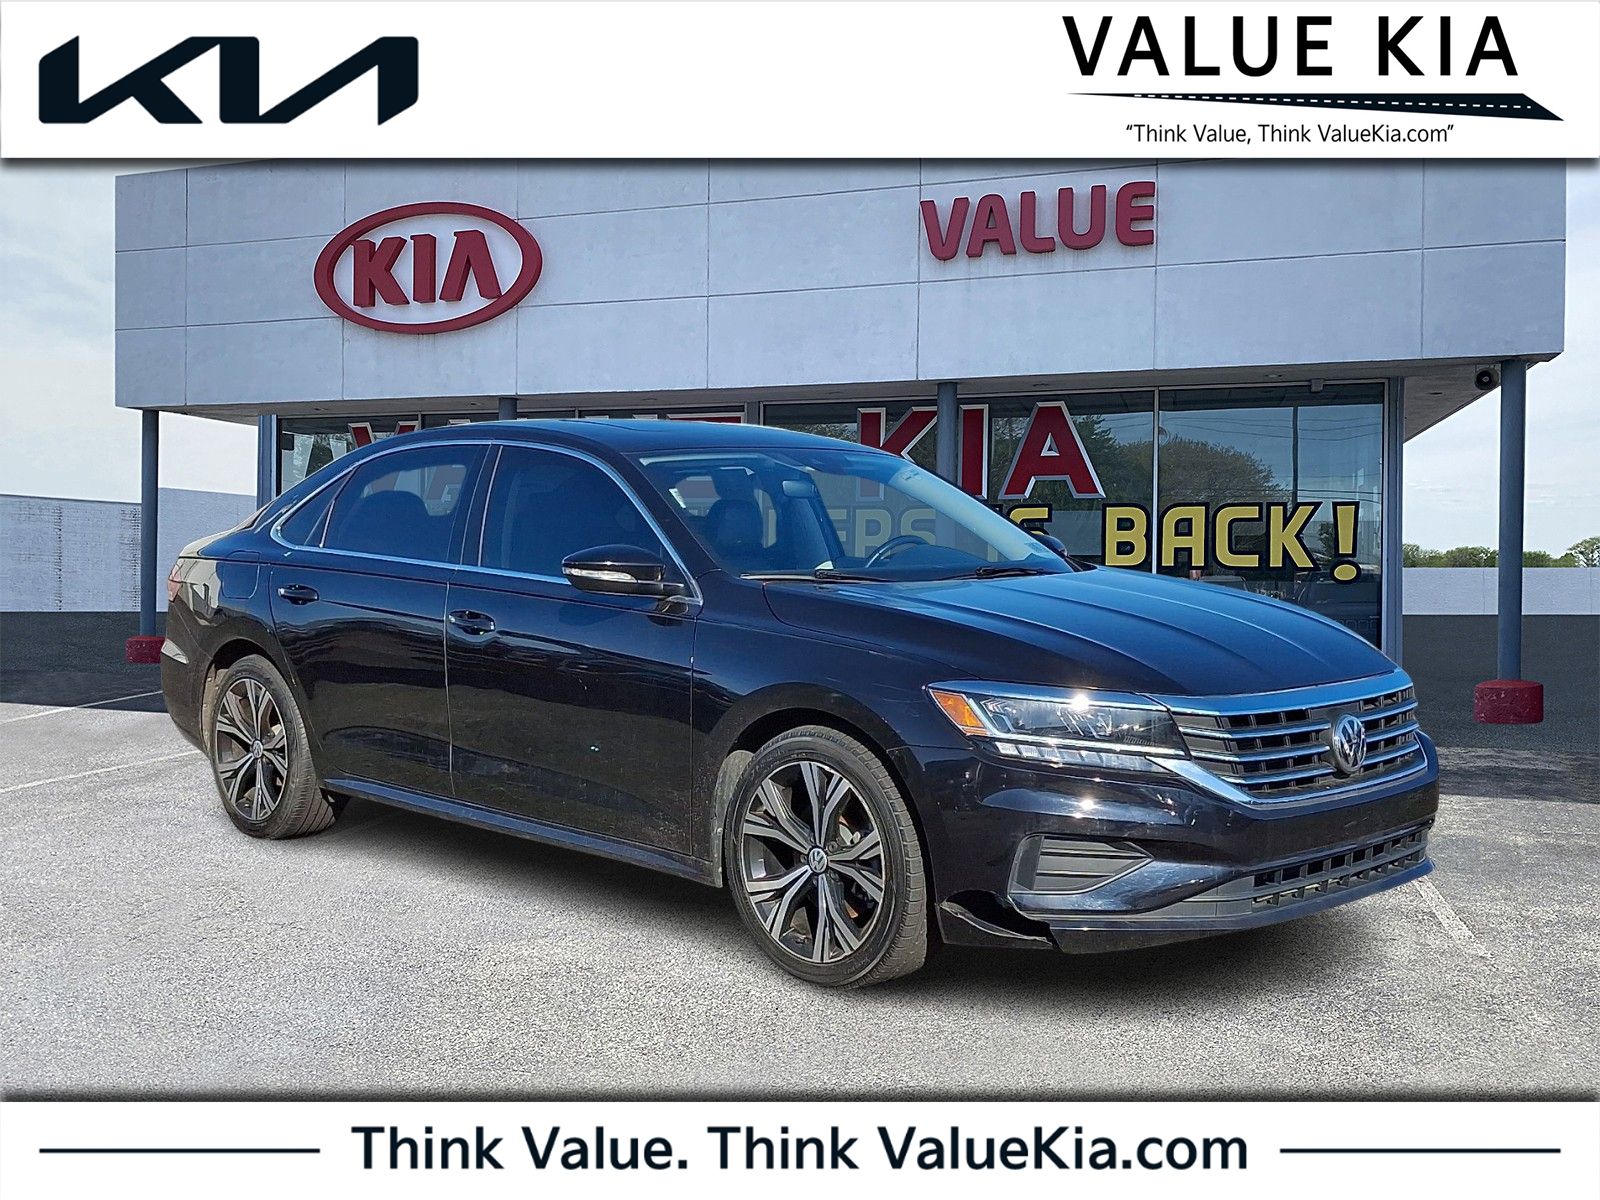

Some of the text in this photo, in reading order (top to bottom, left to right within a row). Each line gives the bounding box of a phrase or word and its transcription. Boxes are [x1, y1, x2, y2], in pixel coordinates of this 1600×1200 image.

[920, 181, 1156, 262] VALUE
[353, 229, 502, 308] KIA
[857, 401, 1106, 500] KIA
[1101, 501, 1362, 585] BACK!
